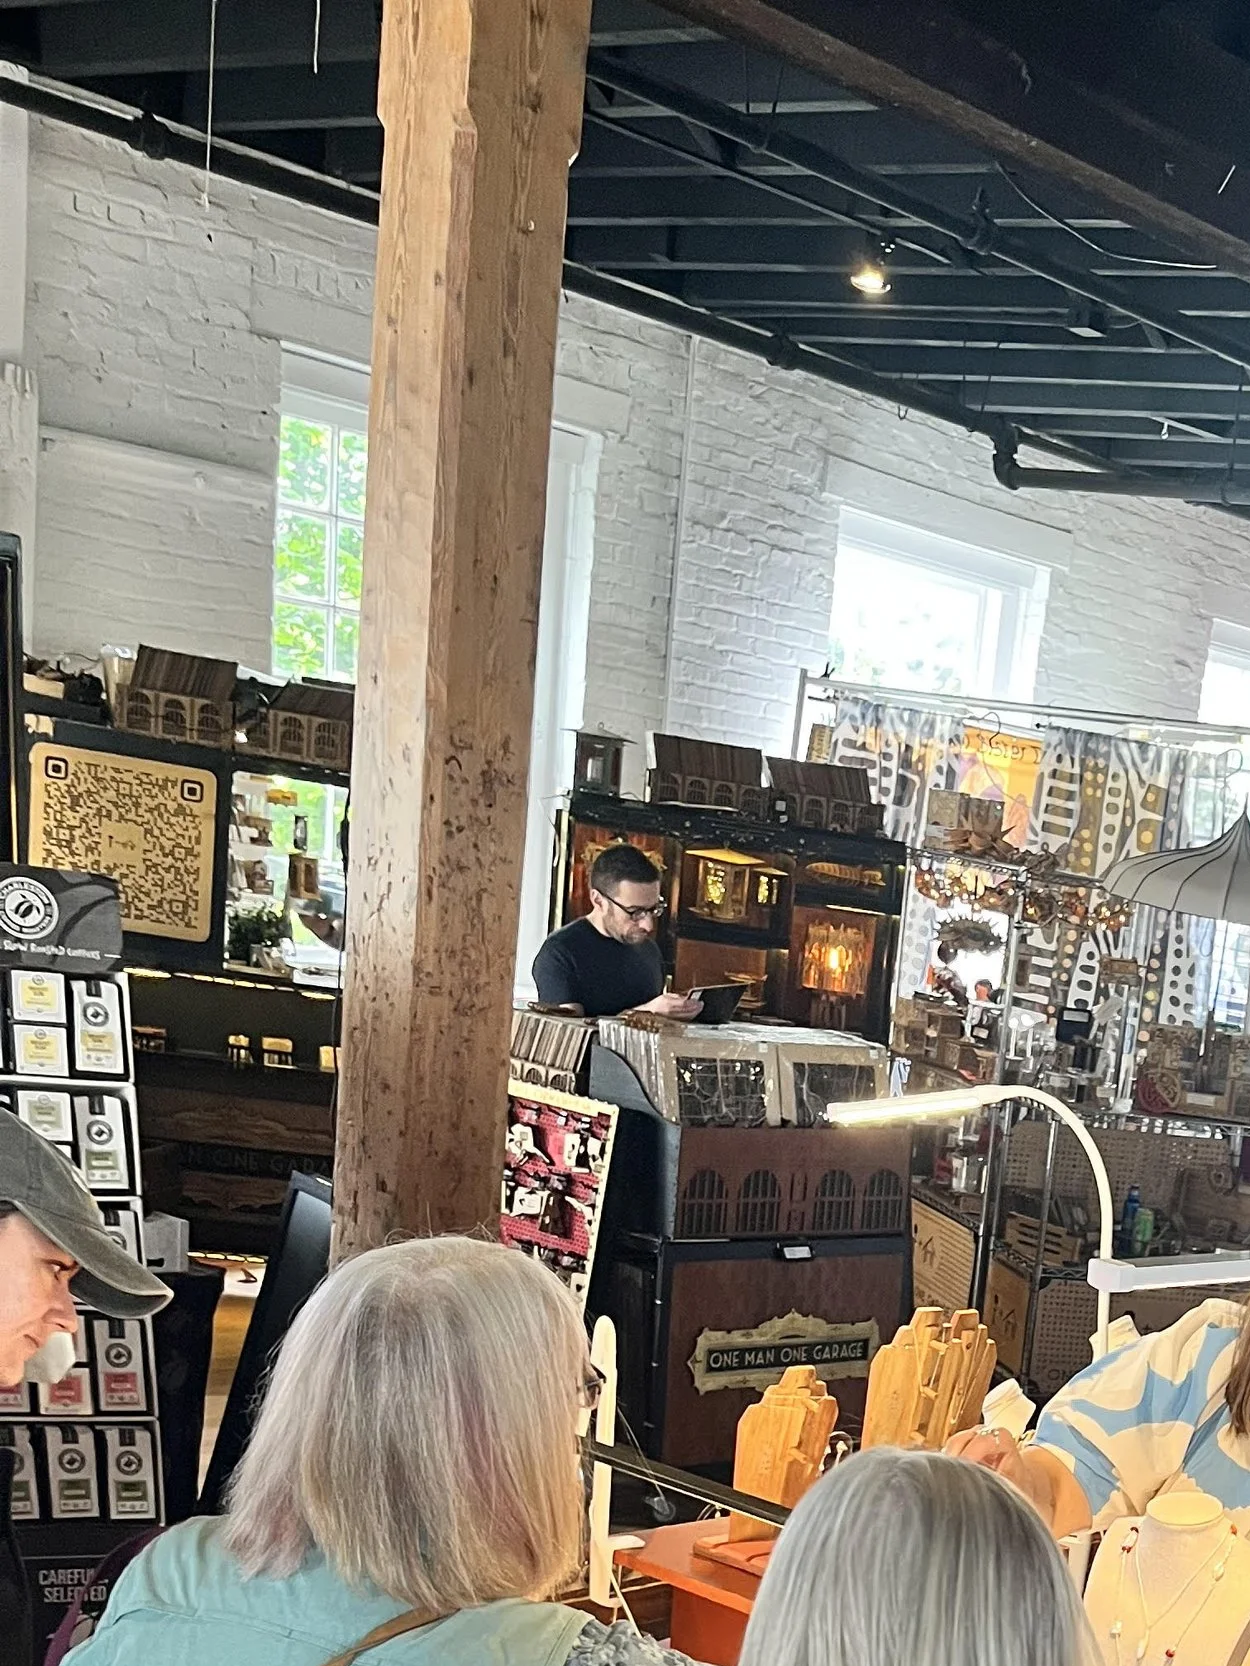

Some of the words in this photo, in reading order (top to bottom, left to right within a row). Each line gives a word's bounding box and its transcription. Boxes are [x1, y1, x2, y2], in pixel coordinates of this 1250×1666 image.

[709, 1351, 740, 1369] ONE
[744, 1348, 775, 1367] MAN
[780, 1345, 808, 1363] ONE
[813, 1341, 864, 1360] GARAGE
